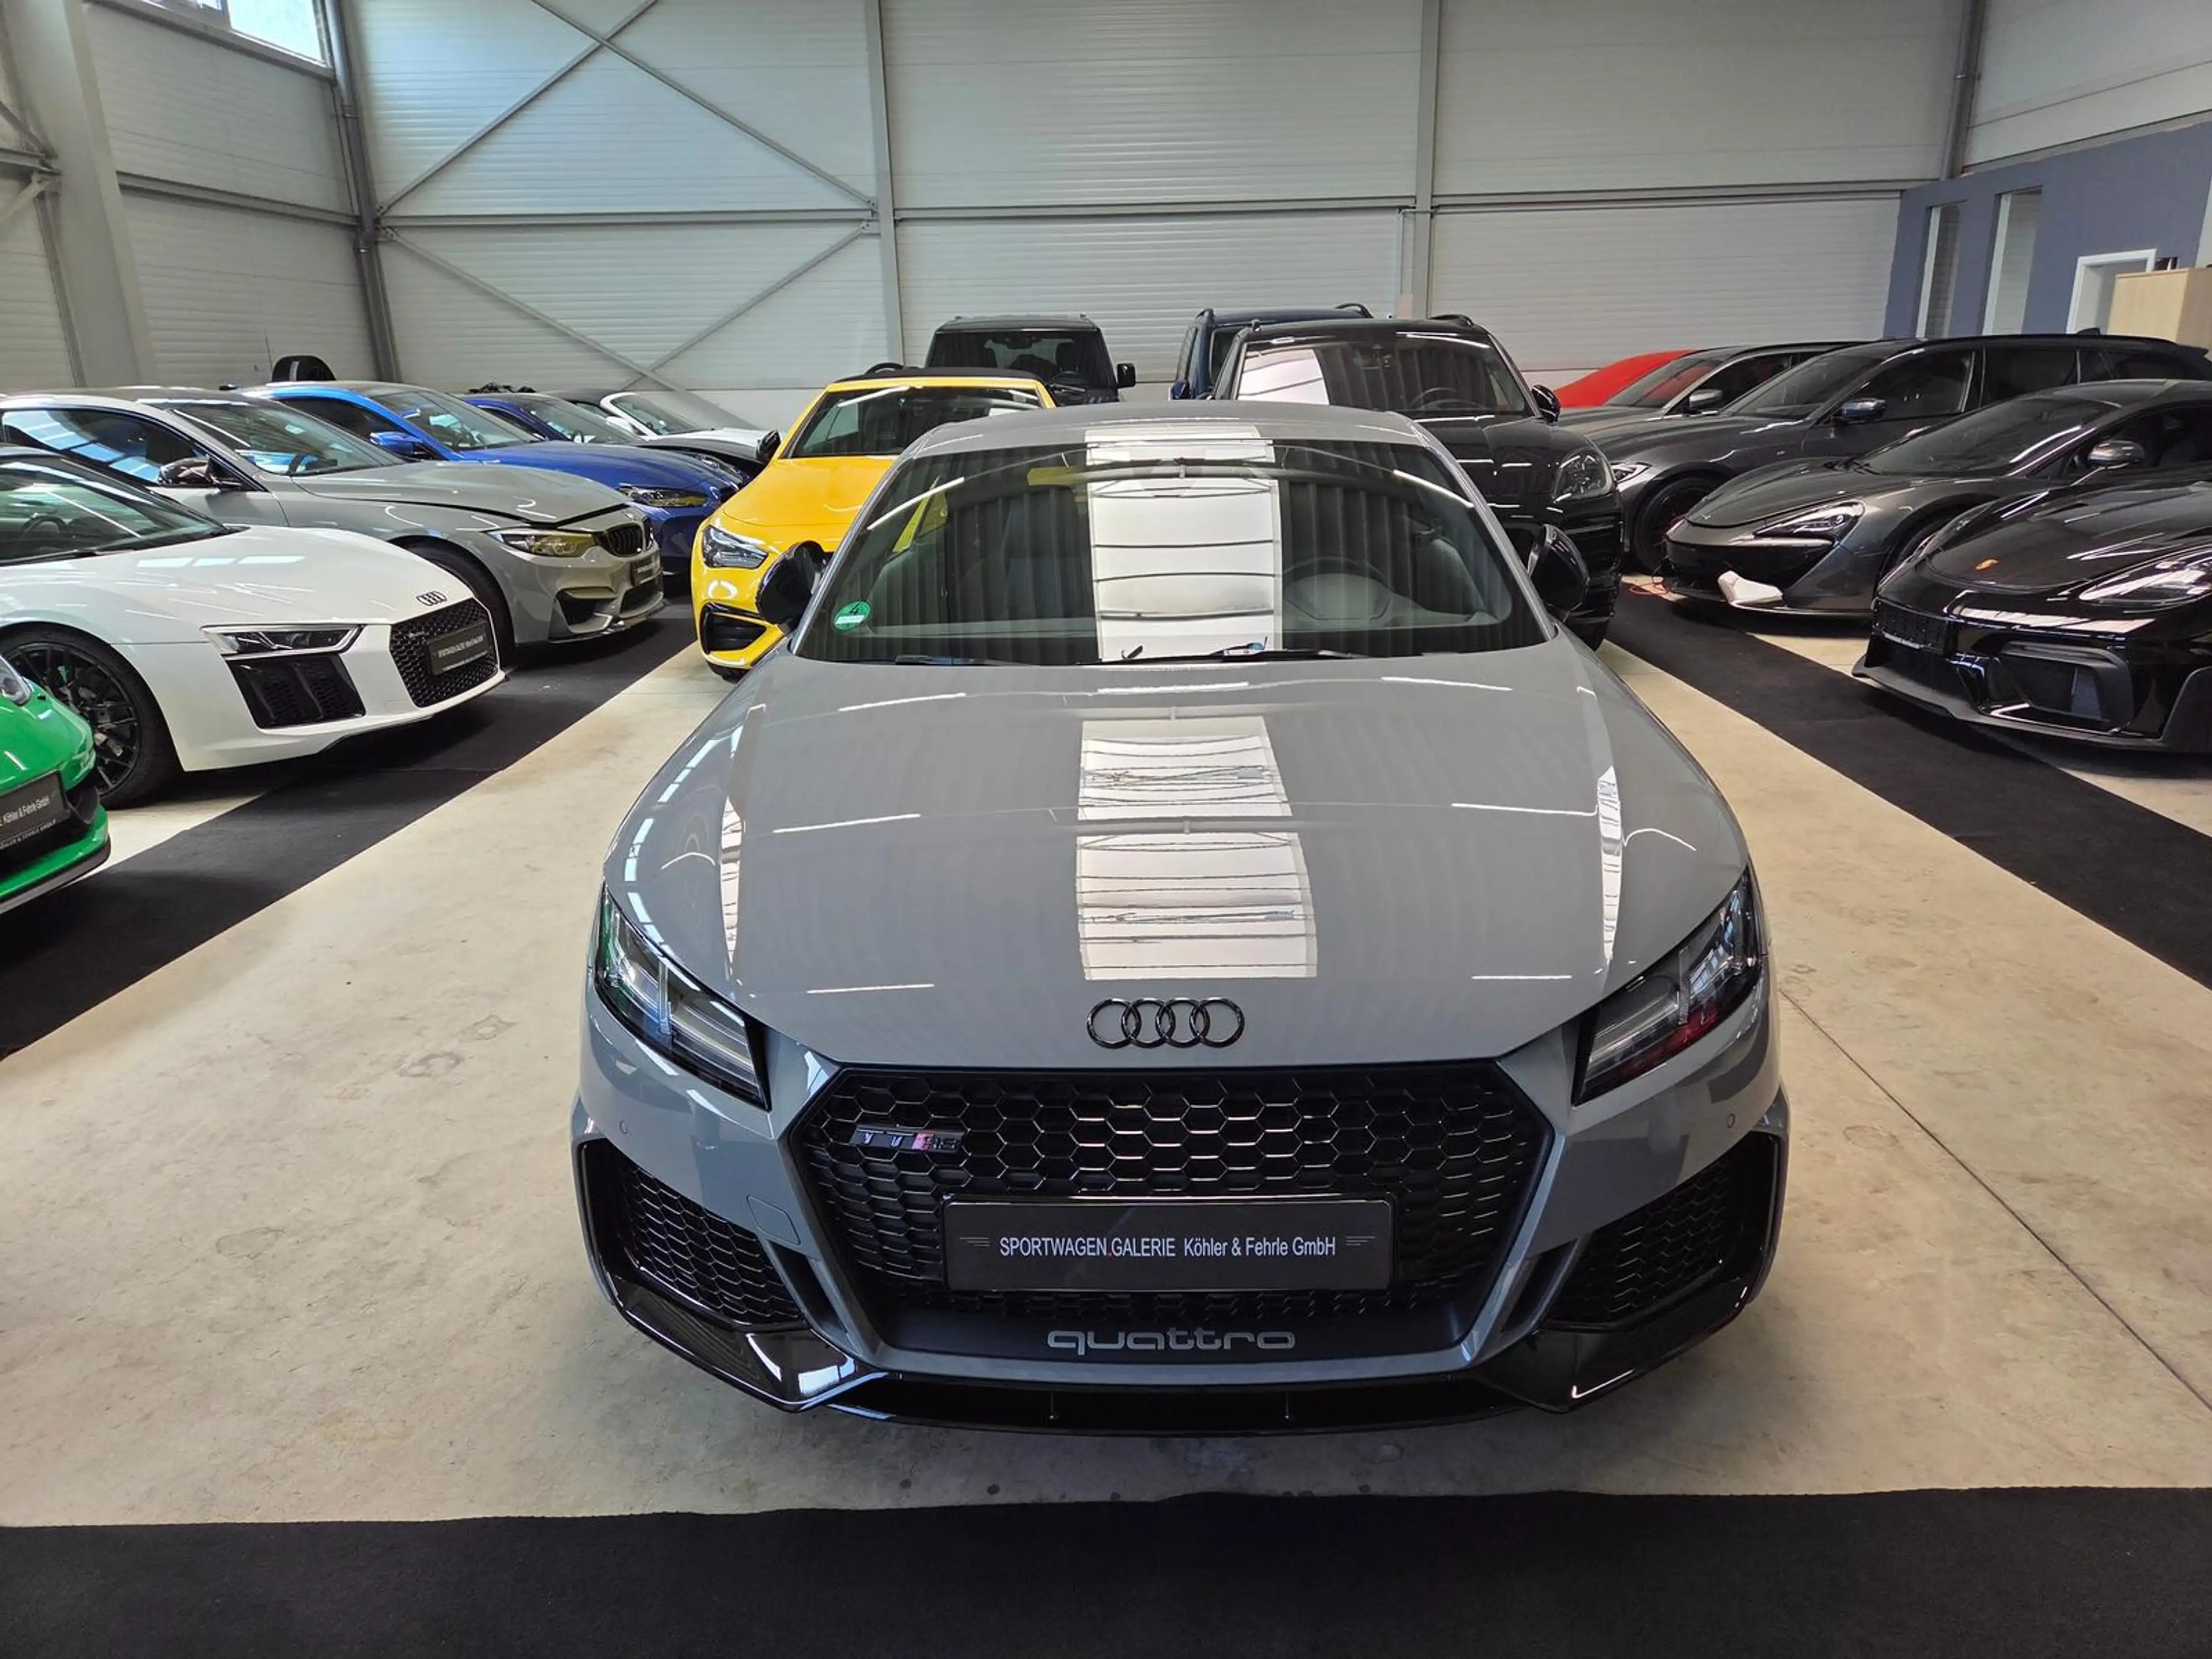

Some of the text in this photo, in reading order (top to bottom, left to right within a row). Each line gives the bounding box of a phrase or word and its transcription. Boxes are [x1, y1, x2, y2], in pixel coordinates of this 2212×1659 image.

[999, 1236, 1336, 1257] SPORTWAGEN.GALERIE Köhler & Fehrle GmbH
[1047, 1327, 1296, 1356] quattro
